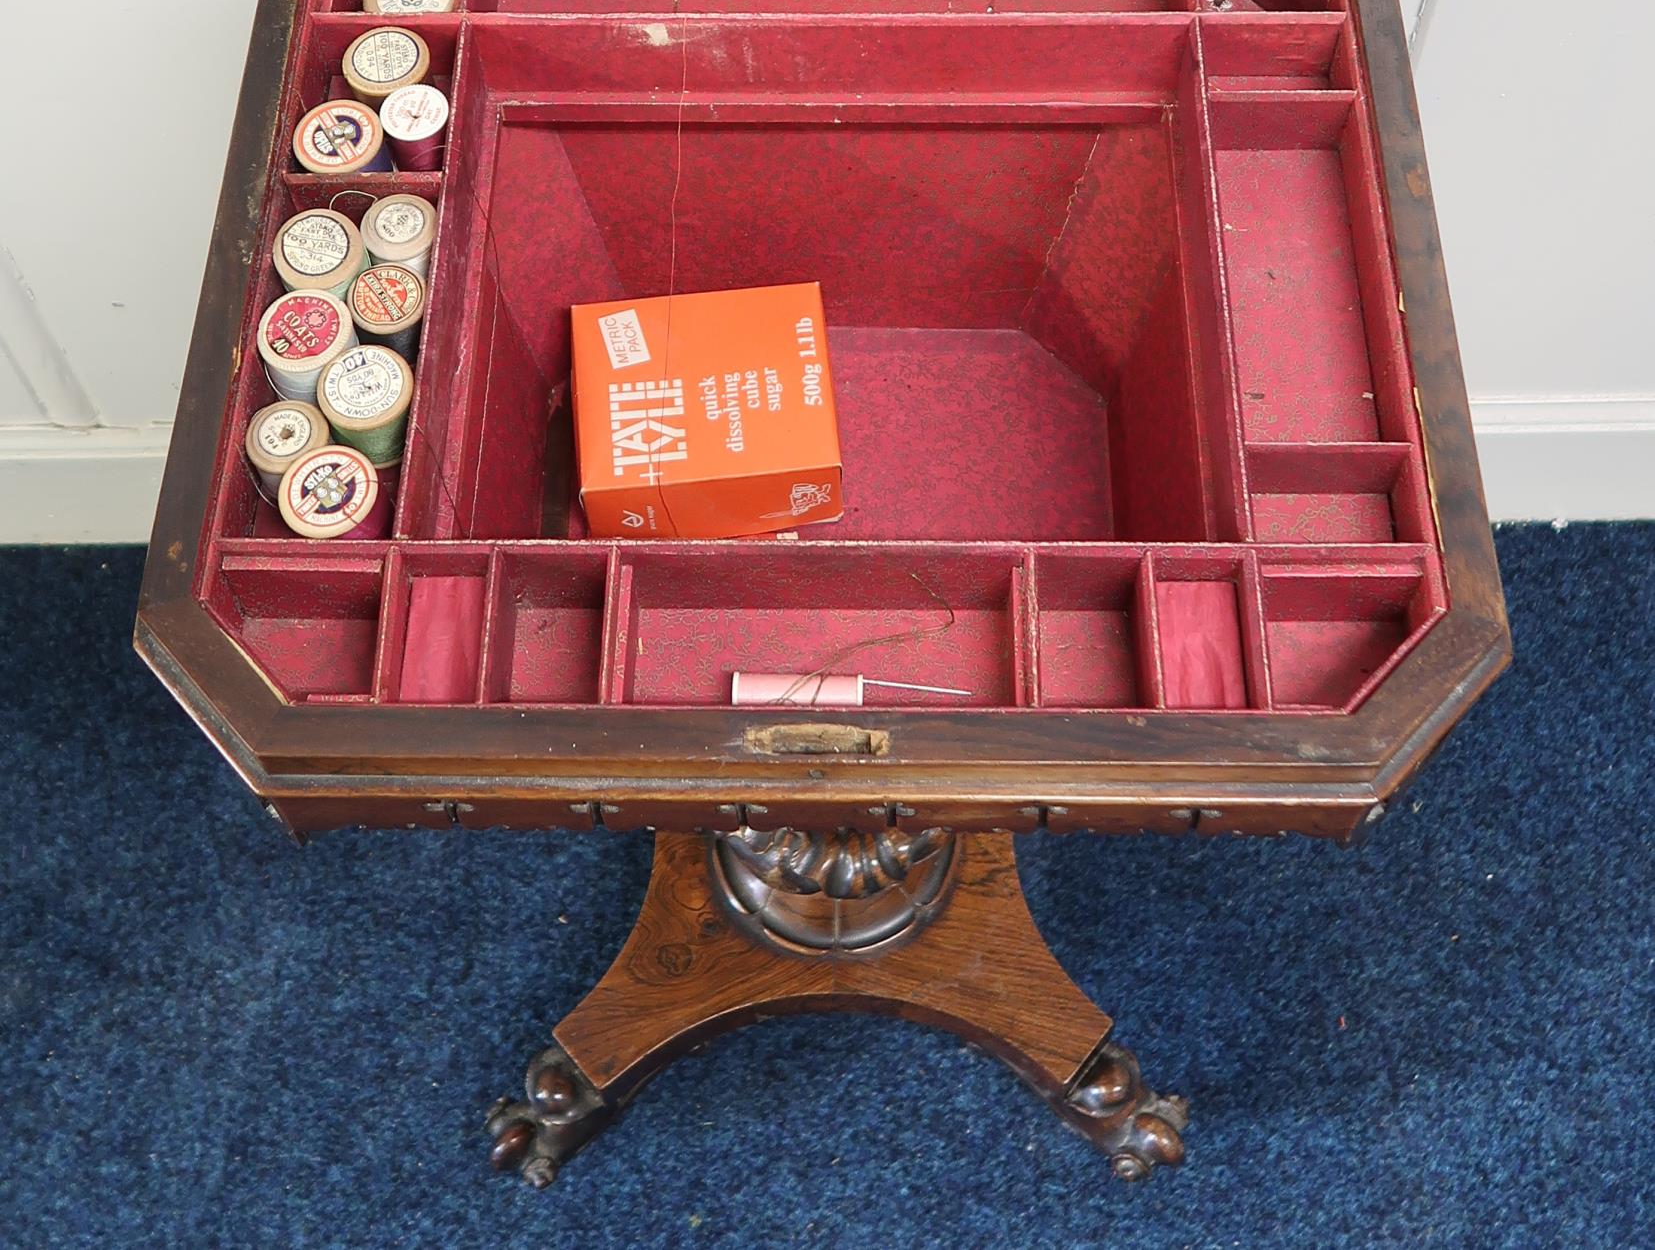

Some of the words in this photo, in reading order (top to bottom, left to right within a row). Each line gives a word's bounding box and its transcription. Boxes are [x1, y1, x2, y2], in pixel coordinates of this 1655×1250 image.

[379, 34, 388, 49] 100
[382, 53, 392, 79] YARDS
[311, 240, 344, 255] YARDS
[311, 261, 335, 272] GREEN
[378, 271, 411, 287] CLARK
[283, 310, 319, 347] COATS
[287, 297, 333, 313] MACHINE
[324, 318, 337, 345] TWIST
[623, 321, 642, 352] PACK
[272, 338, 290, 354] 40
[604, 317, 629, 364] METRIC
[371, 351, 400, 380] MACHINE
[328, 372, 340, 402] TWIST
[698, 375, 717, 421] quick
[741, 370, 761, 409] cube
[764, 367, 783, 411] sugar
[800, 364, 823, 407] 500g
[274, 413, 290, 421] MADE
[645, 379, 688, 462] LYLE
[721, 371, 744, 453] dissolving
[608, 382, 651, 476] TATE
[304, 465, 333, 490] SYLKO
